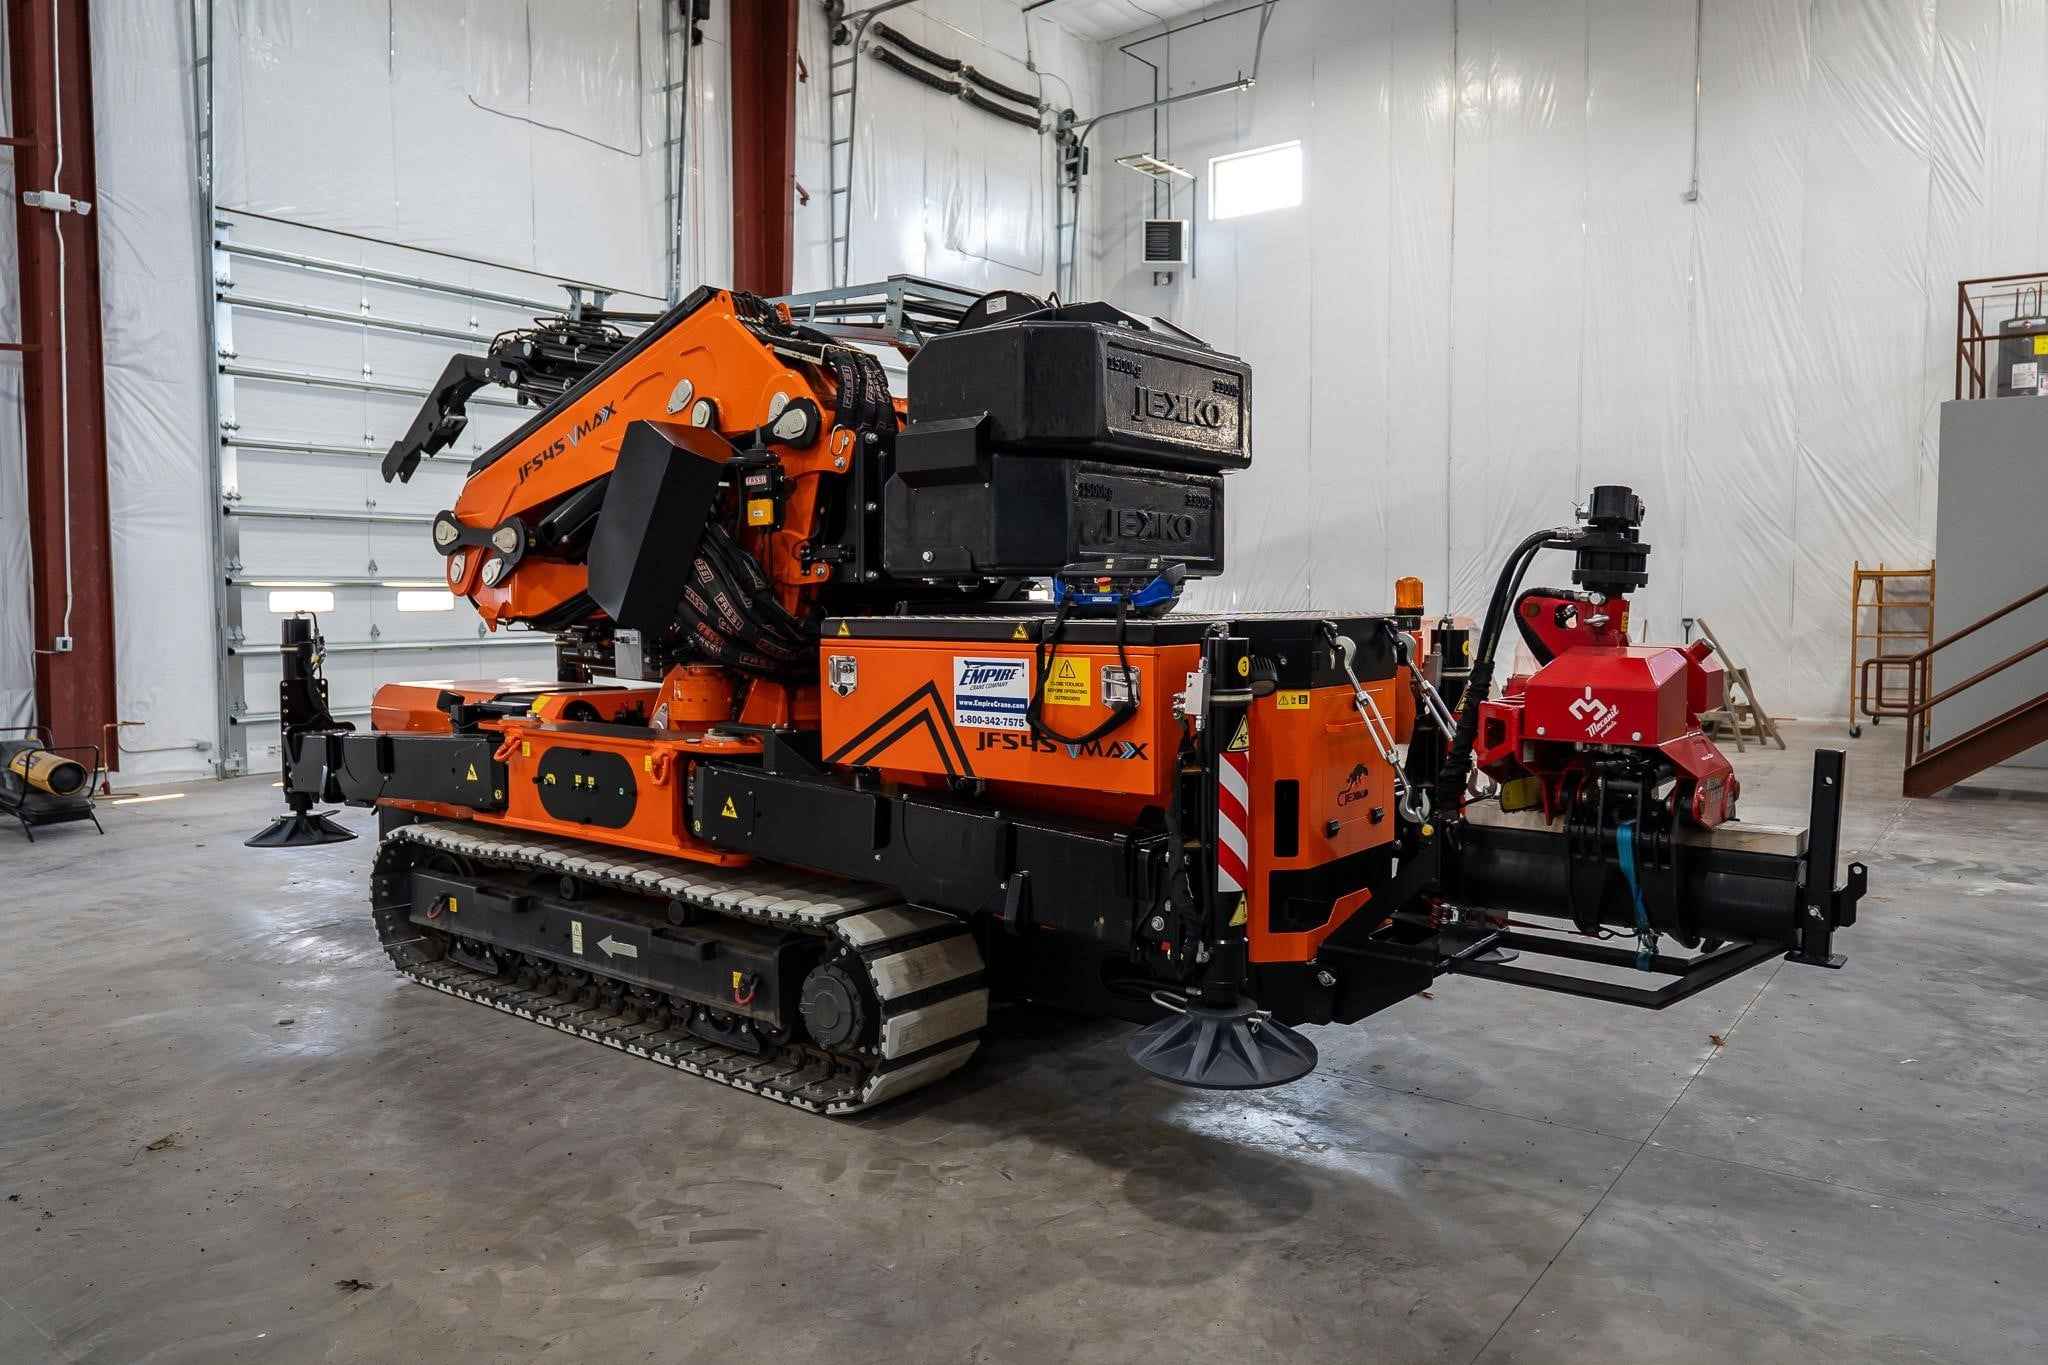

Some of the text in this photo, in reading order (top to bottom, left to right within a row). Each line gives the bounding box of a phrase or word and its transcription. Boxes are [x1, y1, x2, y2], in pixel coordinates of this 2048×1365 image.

[1131, 386, 1221, 429] JEKKO
[714, 592, 744, 631] FASSI
[959, 668, 1019, 686] EMPIRE
[959, 700, 1025, 709] www.EmpireCrane.com
[960, 714, 1025, 727] 1-800-342-7575
